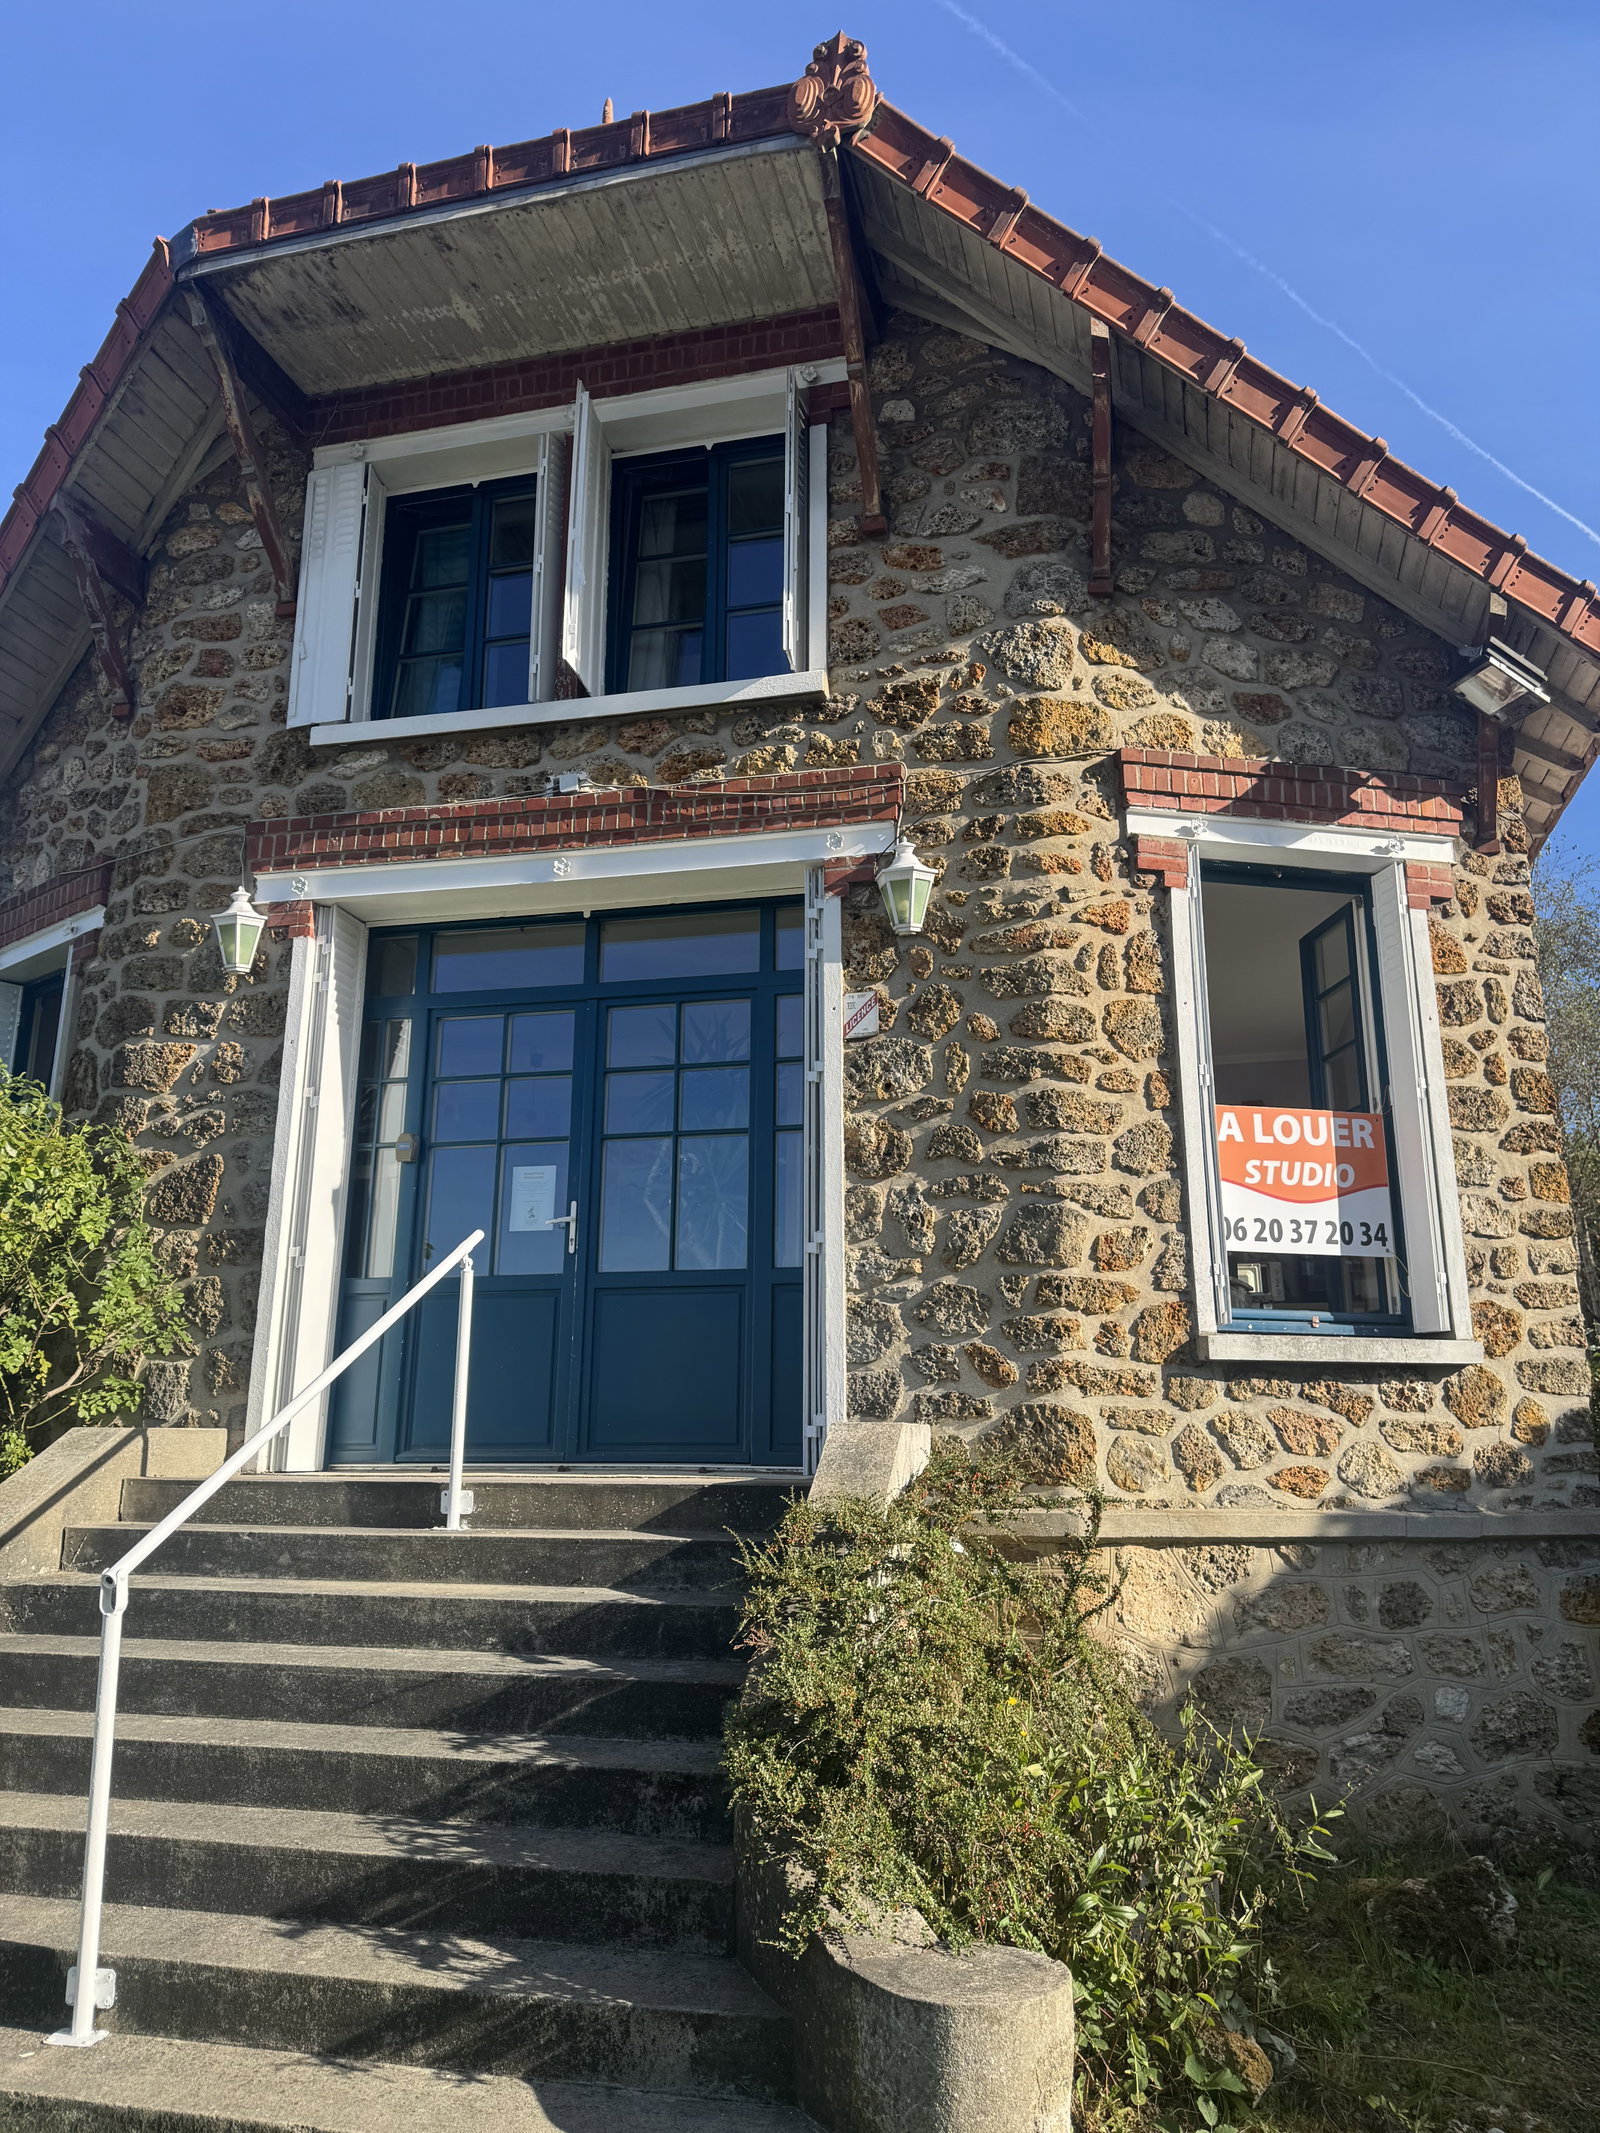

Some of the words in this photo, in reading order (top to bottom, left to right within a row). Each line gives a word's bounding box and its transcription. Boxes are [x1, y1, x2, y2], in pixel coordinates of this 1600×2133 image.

[845, 995, 876, 1033] LICENCE
[1218, 1112, 1244, 1142] A
[1253, 1113, 1375, 1149] LOUER
[1245, 1159, 1355, 1188] STUDIO
[1253, 1217, 1283, 1243] 20
[1290, 1219, 1318, 1244] 37
[1325, 1220, 1354, 1246] 20
[1360, 1222, 1388, 1247] 34
